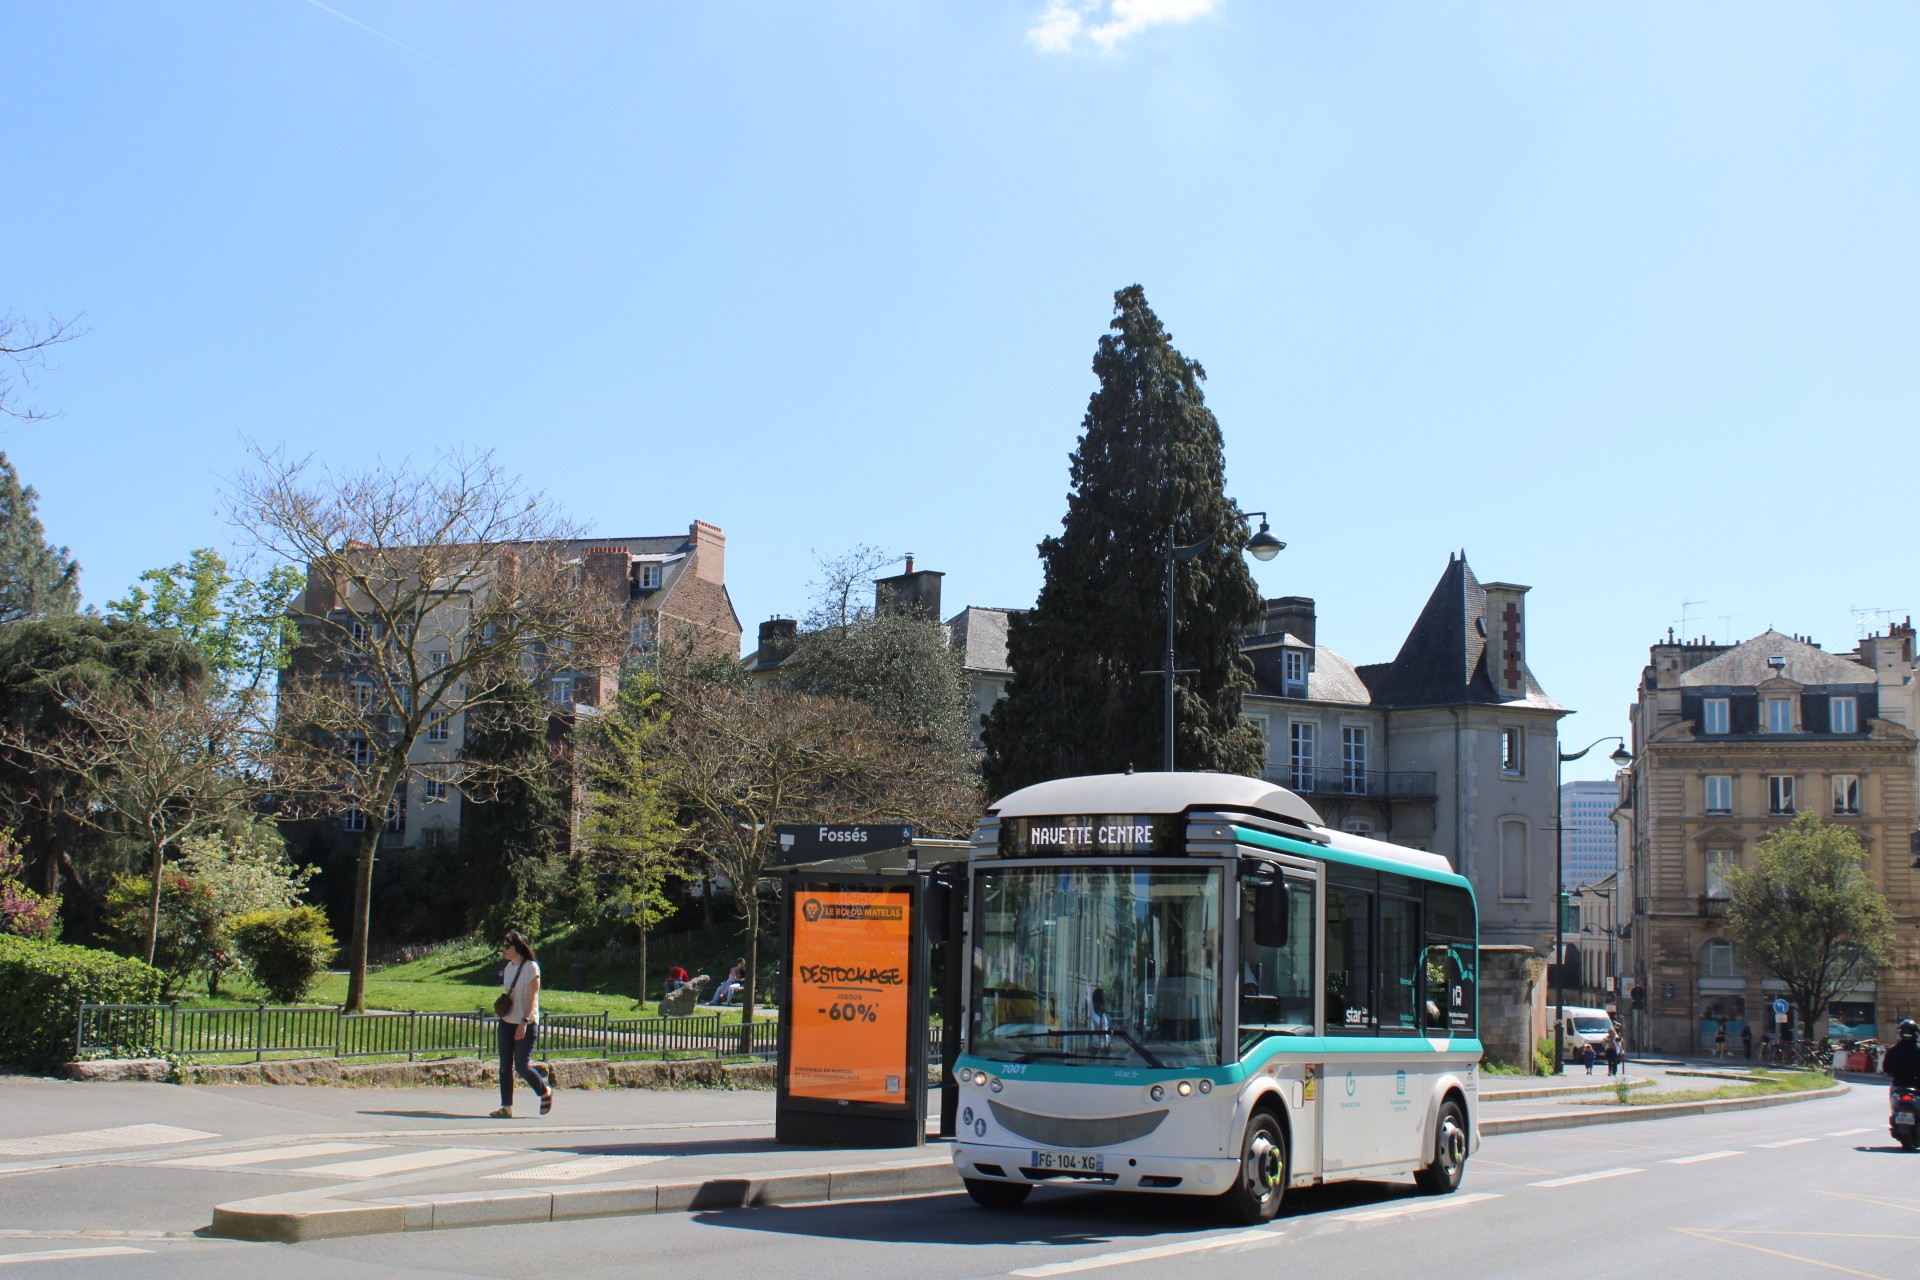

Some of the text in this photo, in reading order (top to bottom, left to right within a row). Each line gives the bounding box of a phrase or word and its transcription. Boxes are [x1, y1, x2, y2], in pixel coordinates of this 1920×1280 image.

[819, 827, 868, 842] Fossés
[1031, 825, 1154, 845] NAVETTE CENTRE
[825, 908, 900, 917] LE ROI DU MATELAS
[800, 965, 903, 985] DESTOCKAGE
[1346, 1006, 1361, 1024] star
[1001, 1064, 1027, 1075] 7001
[1114, 1070, 1139, 1079] star.fr
[1038, 1153, 1096, 1170] FG-104-XG
